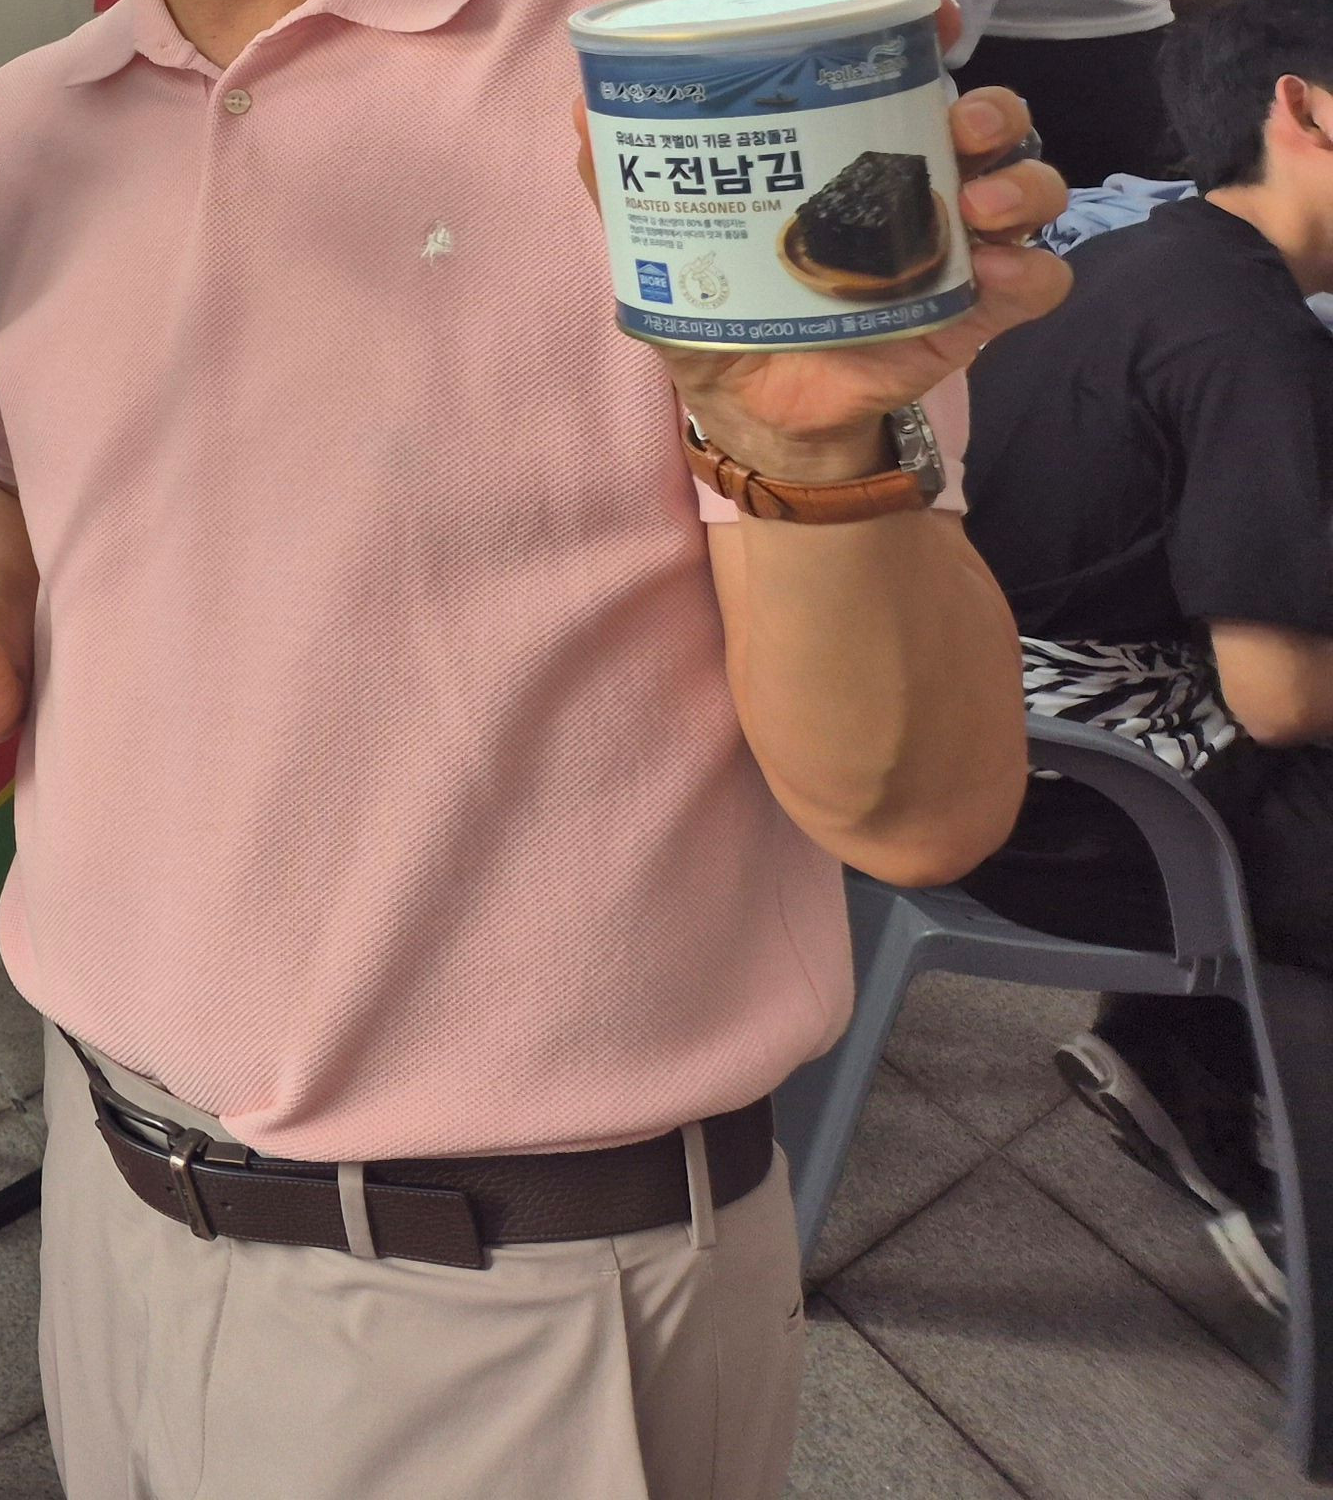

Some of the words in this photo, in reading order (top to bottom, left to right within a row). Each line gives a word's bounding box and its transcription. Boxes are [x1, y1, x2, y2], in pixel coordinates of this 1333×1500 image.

[659, 132, 699, 149] 갯벌이
[702, 132, 732, 149] 키운
[618, 150, 805, 197] K-전남김
[674, 201, 747, 214] SEASONED
[752, 199, 782, 213] GIM
[725, 322, 745, 337] 33
[748, 321, 795, 340] g(200
[798, 317, 837, 336] kcal)
